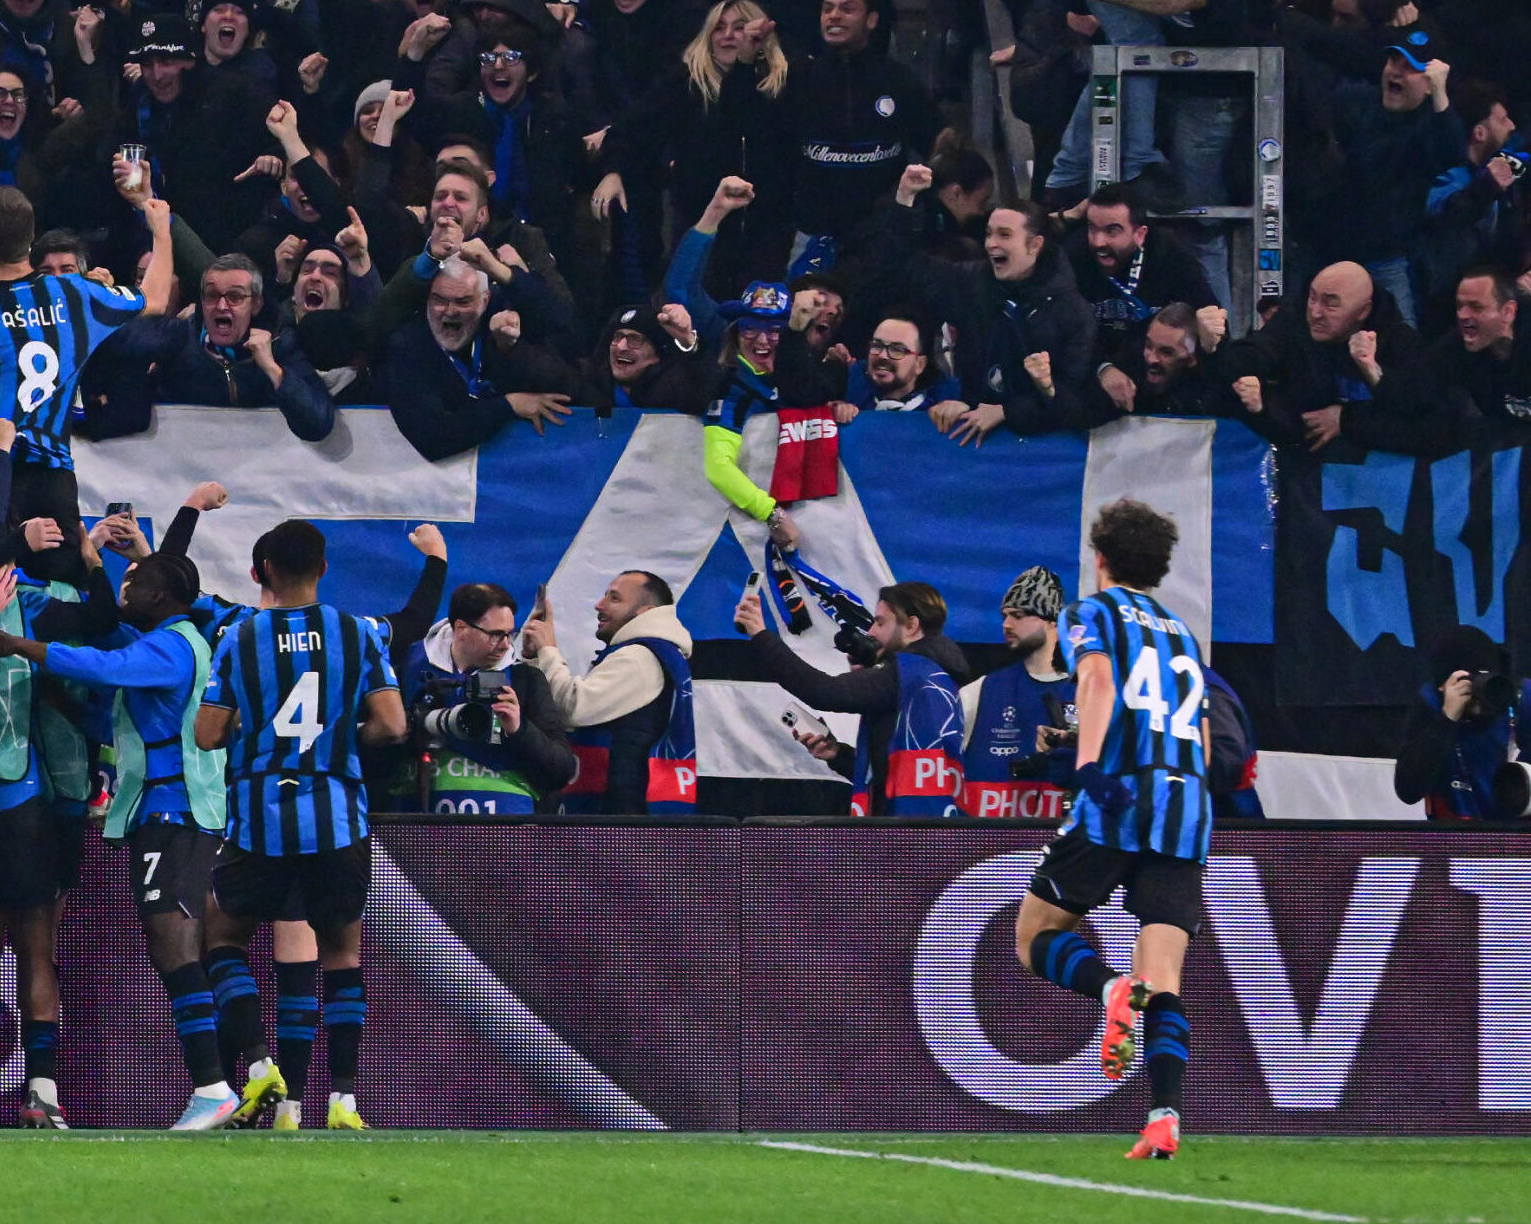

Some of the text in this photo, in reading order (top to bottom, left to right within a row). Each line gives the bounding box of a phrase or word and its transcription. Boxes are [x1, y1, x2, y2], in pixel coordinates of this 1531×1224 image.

[17, 340, 60, 413] 8
[278, 631, 322, 653] HIEN
[272, 671, 324, 754] 4
[1122, 646, 1204, 747] 42
[989, 746, 1019, 757] oppo
[143, 852, 162, 885] 7
